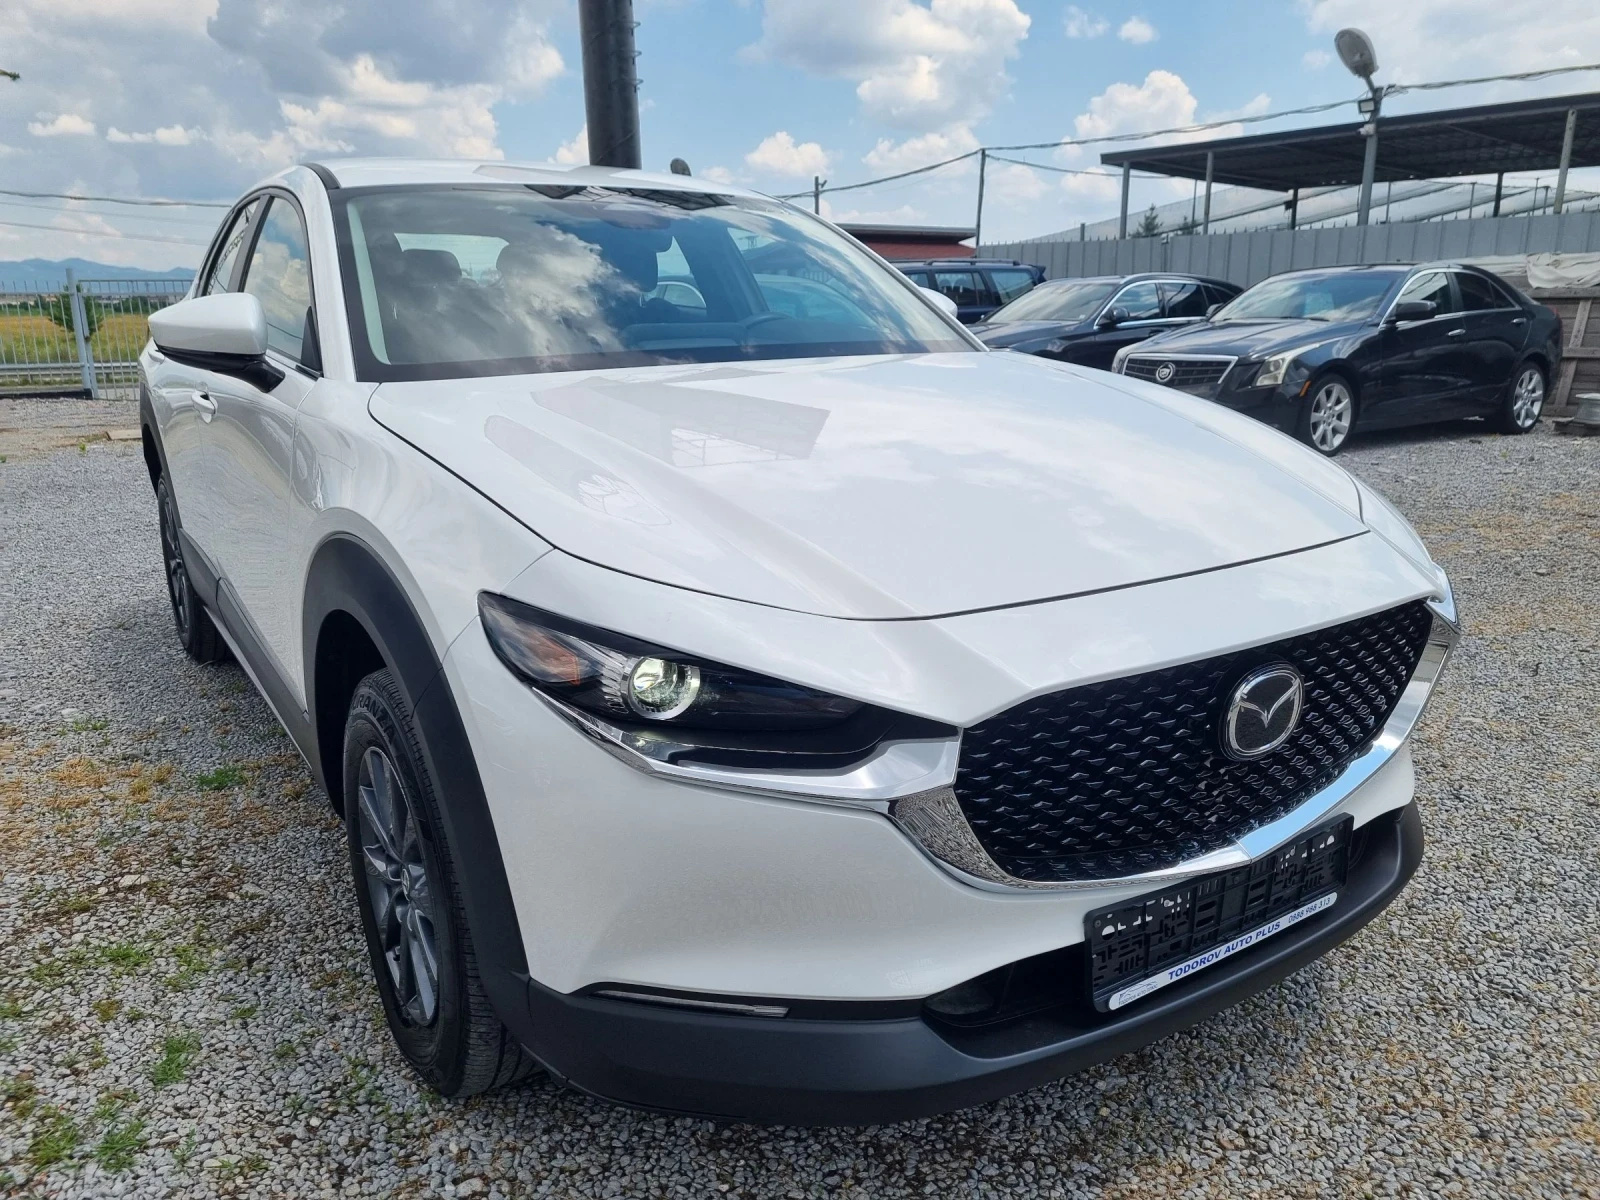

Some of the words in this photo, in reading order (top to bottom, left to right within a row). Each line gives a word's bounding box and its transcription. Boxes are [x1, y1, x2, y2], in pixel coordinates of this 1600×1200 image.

[1168, 949, 1222, 980] TODOROV
[1224, 935, 1252, 955] AUTO
[1255, 921, 1281, 940] PLUS
[1318, 897, 1331, 909] 313
